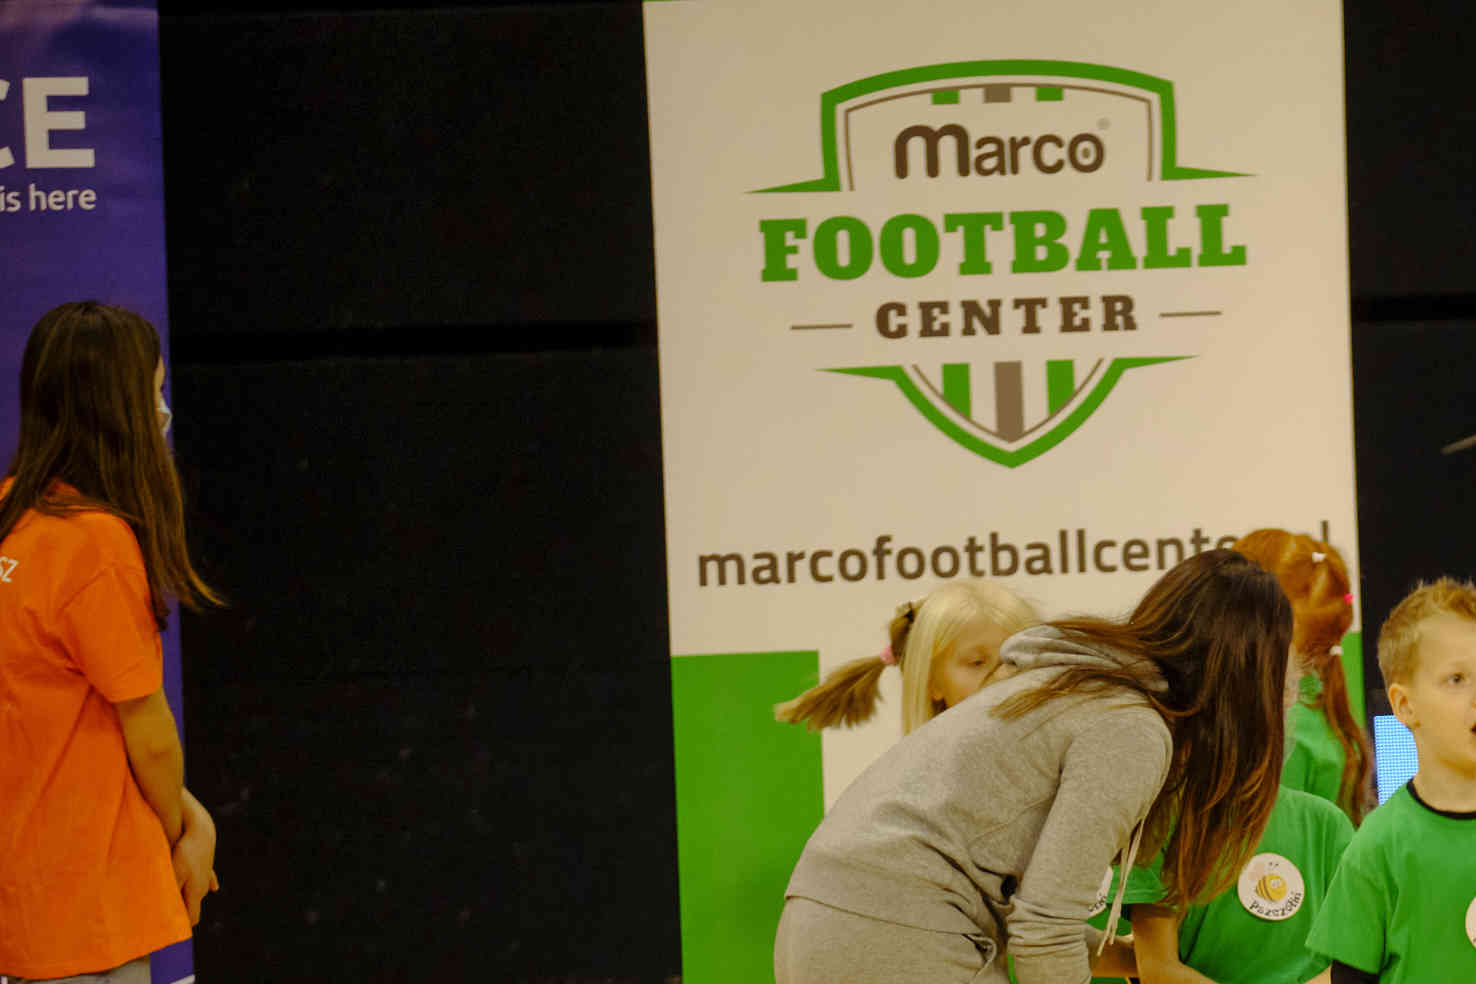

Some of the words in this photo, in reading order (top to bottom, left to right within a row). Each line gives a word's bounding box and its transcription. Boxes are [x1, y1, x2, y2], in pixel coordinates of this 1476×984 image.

[0, 77, 95, 168] E
[893, 123, 1105, 180] marco
[29, 183, 97, 211] here
[759, 203, 1248, 283] FOOTBALL
[874, 294, 1139, 340] CENTER
